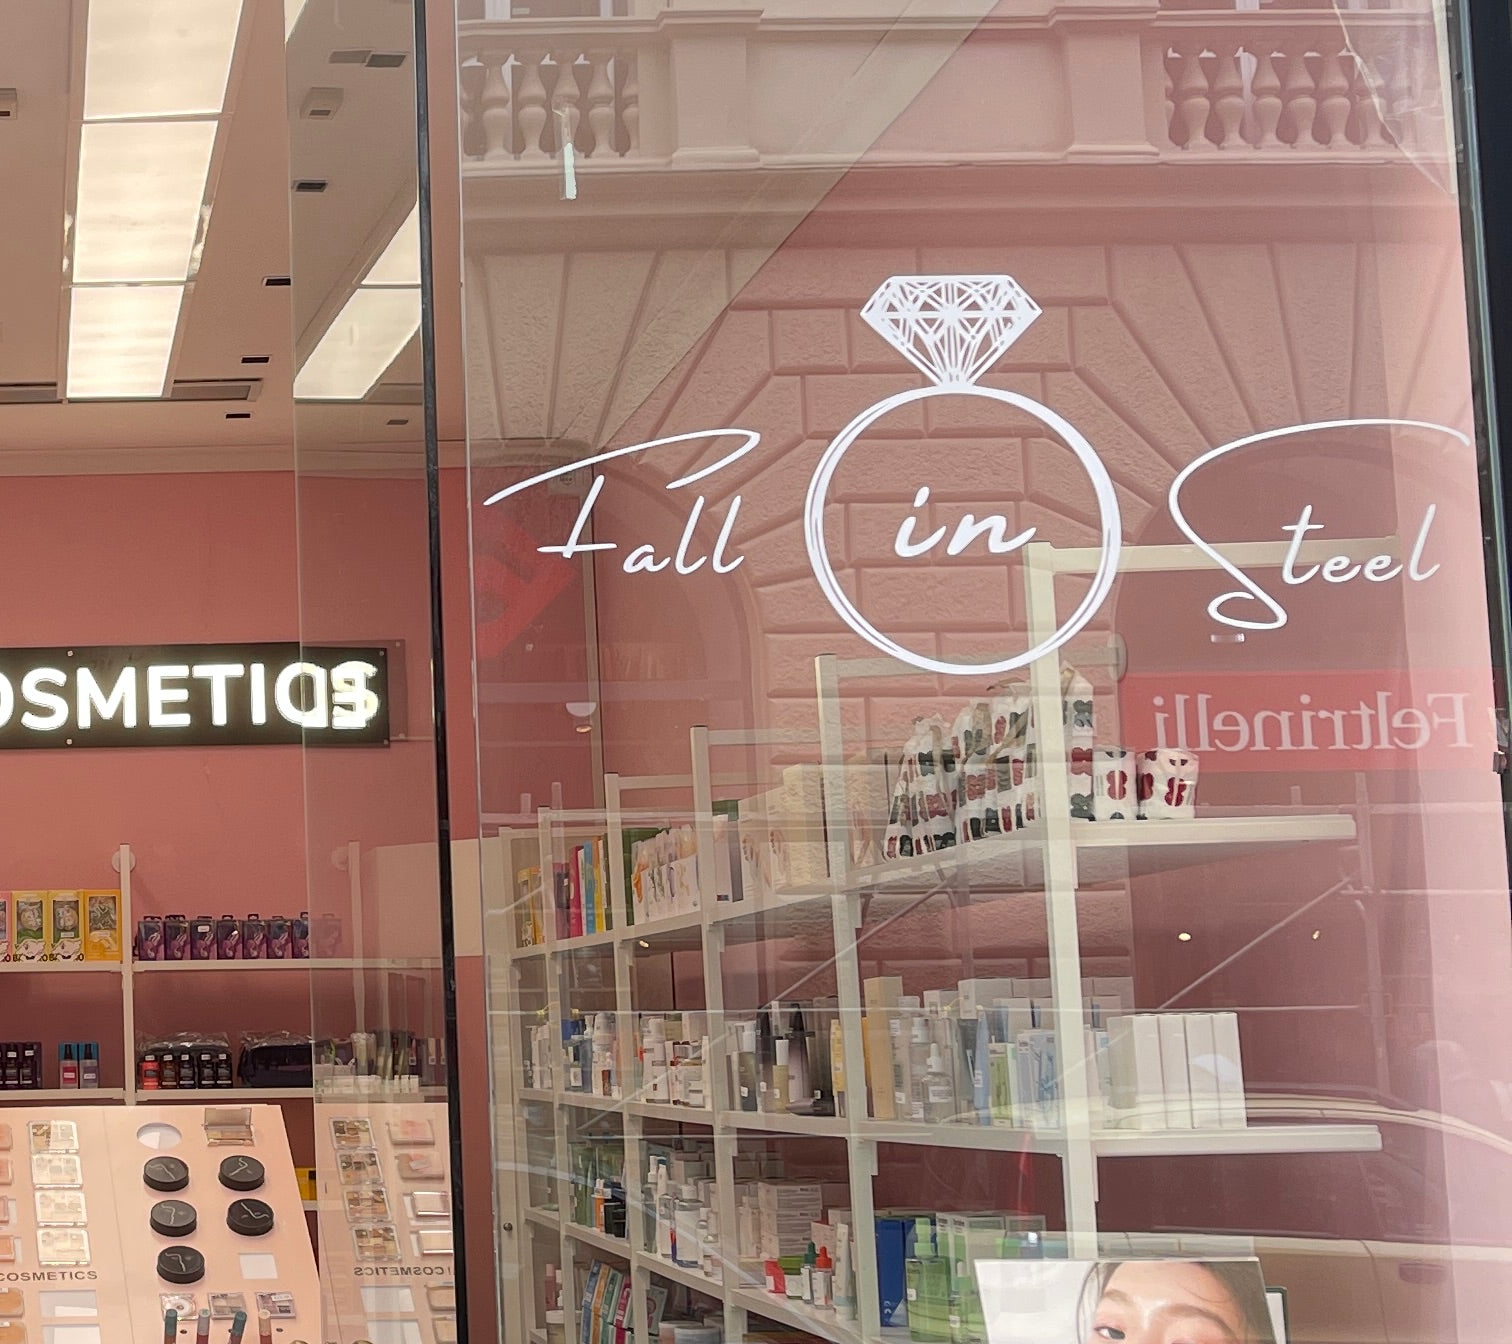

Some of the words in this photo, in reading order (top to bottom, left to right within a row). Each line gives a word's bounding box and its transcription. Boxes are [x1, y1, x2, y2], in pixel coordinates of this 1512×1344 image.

[482, 428, 761, 575] Fall
[893, 485, 1037, 558] in
[1168, 418, 1471, 630] Steel
